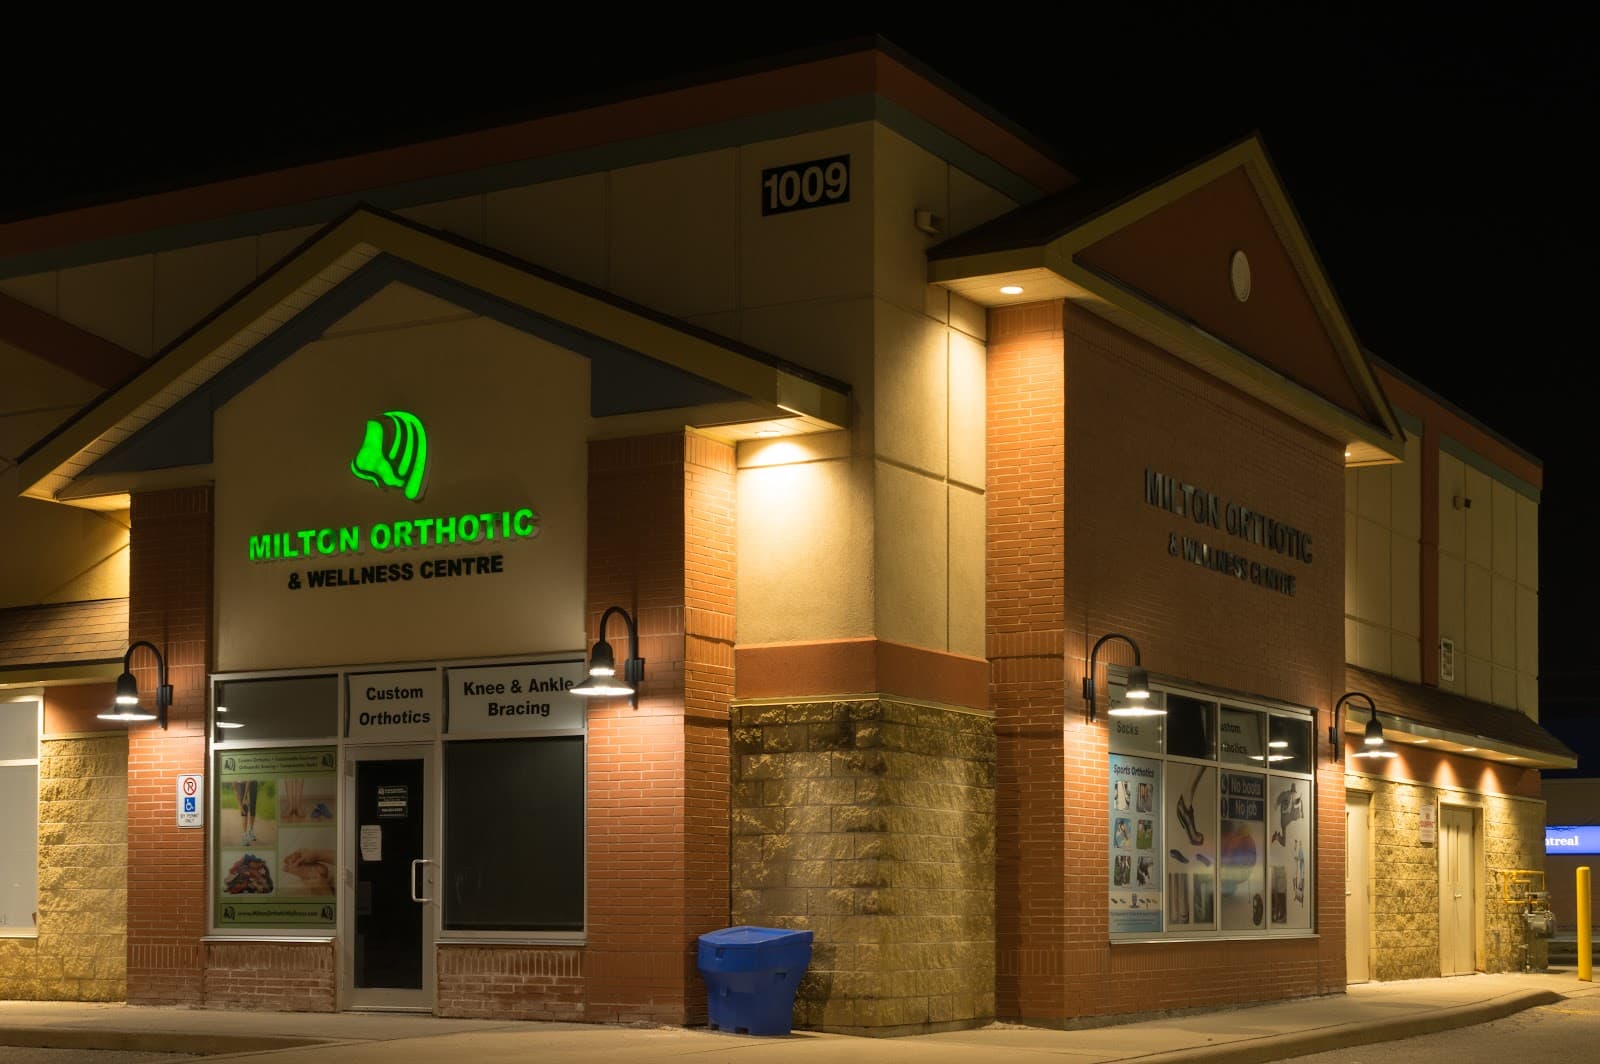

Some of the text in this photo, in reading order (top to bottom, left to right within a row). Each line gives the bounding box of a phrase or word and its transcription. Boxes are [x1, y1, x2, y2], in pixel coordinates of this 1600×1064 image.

[765, 161, 848, 209] 1009
[1144, 466, 1312, 564] MILTON ORTHOTIC
[249, 508, 534, 561] MILTON ORTHOTIC
[288, 555, 504, 590] & WELLNESS CENTRE
[1168, 532, 1178, 557] &
[1250, 561, 1297, 597] CENTRE
[366, 687, 424, 701] Custom
[463, 677, 574, 696] Knee & Ankle
[488, 700, 551, 717] Bracing
[359, 711, 431, 726] Orthotics
[1116, 720, 1139, 736] Socks
[1113, 764, 1155, 779] Sports Orthotics
